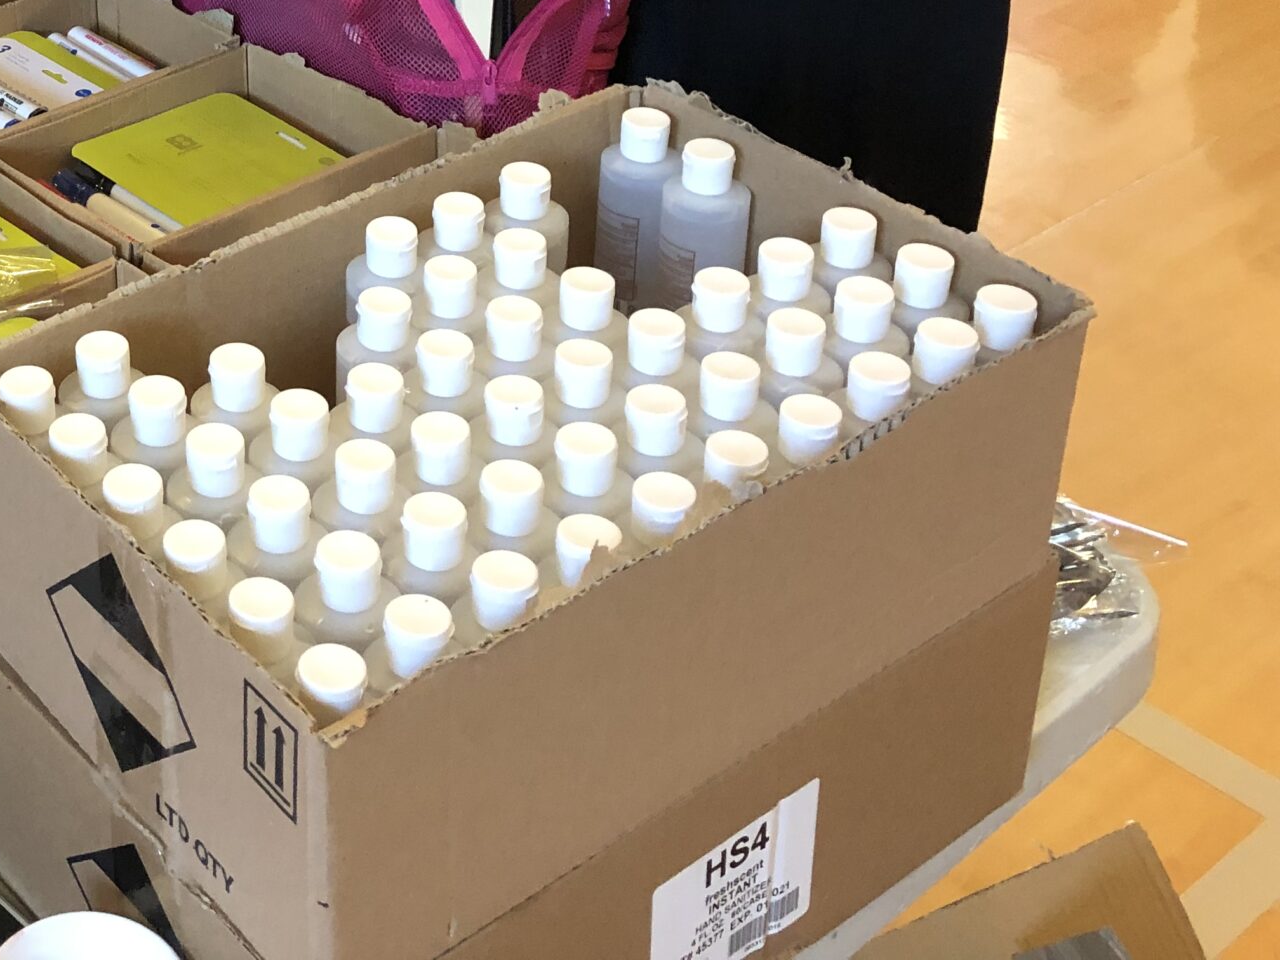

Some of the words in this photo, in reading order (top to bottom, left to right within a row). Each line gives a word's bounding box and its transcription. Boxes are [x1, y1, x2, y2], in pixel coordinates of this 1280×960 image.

[155, 792, 190, 843] LTD
[193, 839, 235, 894] QTY
[705, 821, 770, 889] HS4
[705, 859, 764, 907] freshscent
[708, 872, 758, 916] INSTANT
[691, 938, 697, 948] 4
[712, 920, 725, 934] OZ
[694, 928, 725, 955] 45377
[695, 912, 721, 935] HAND
